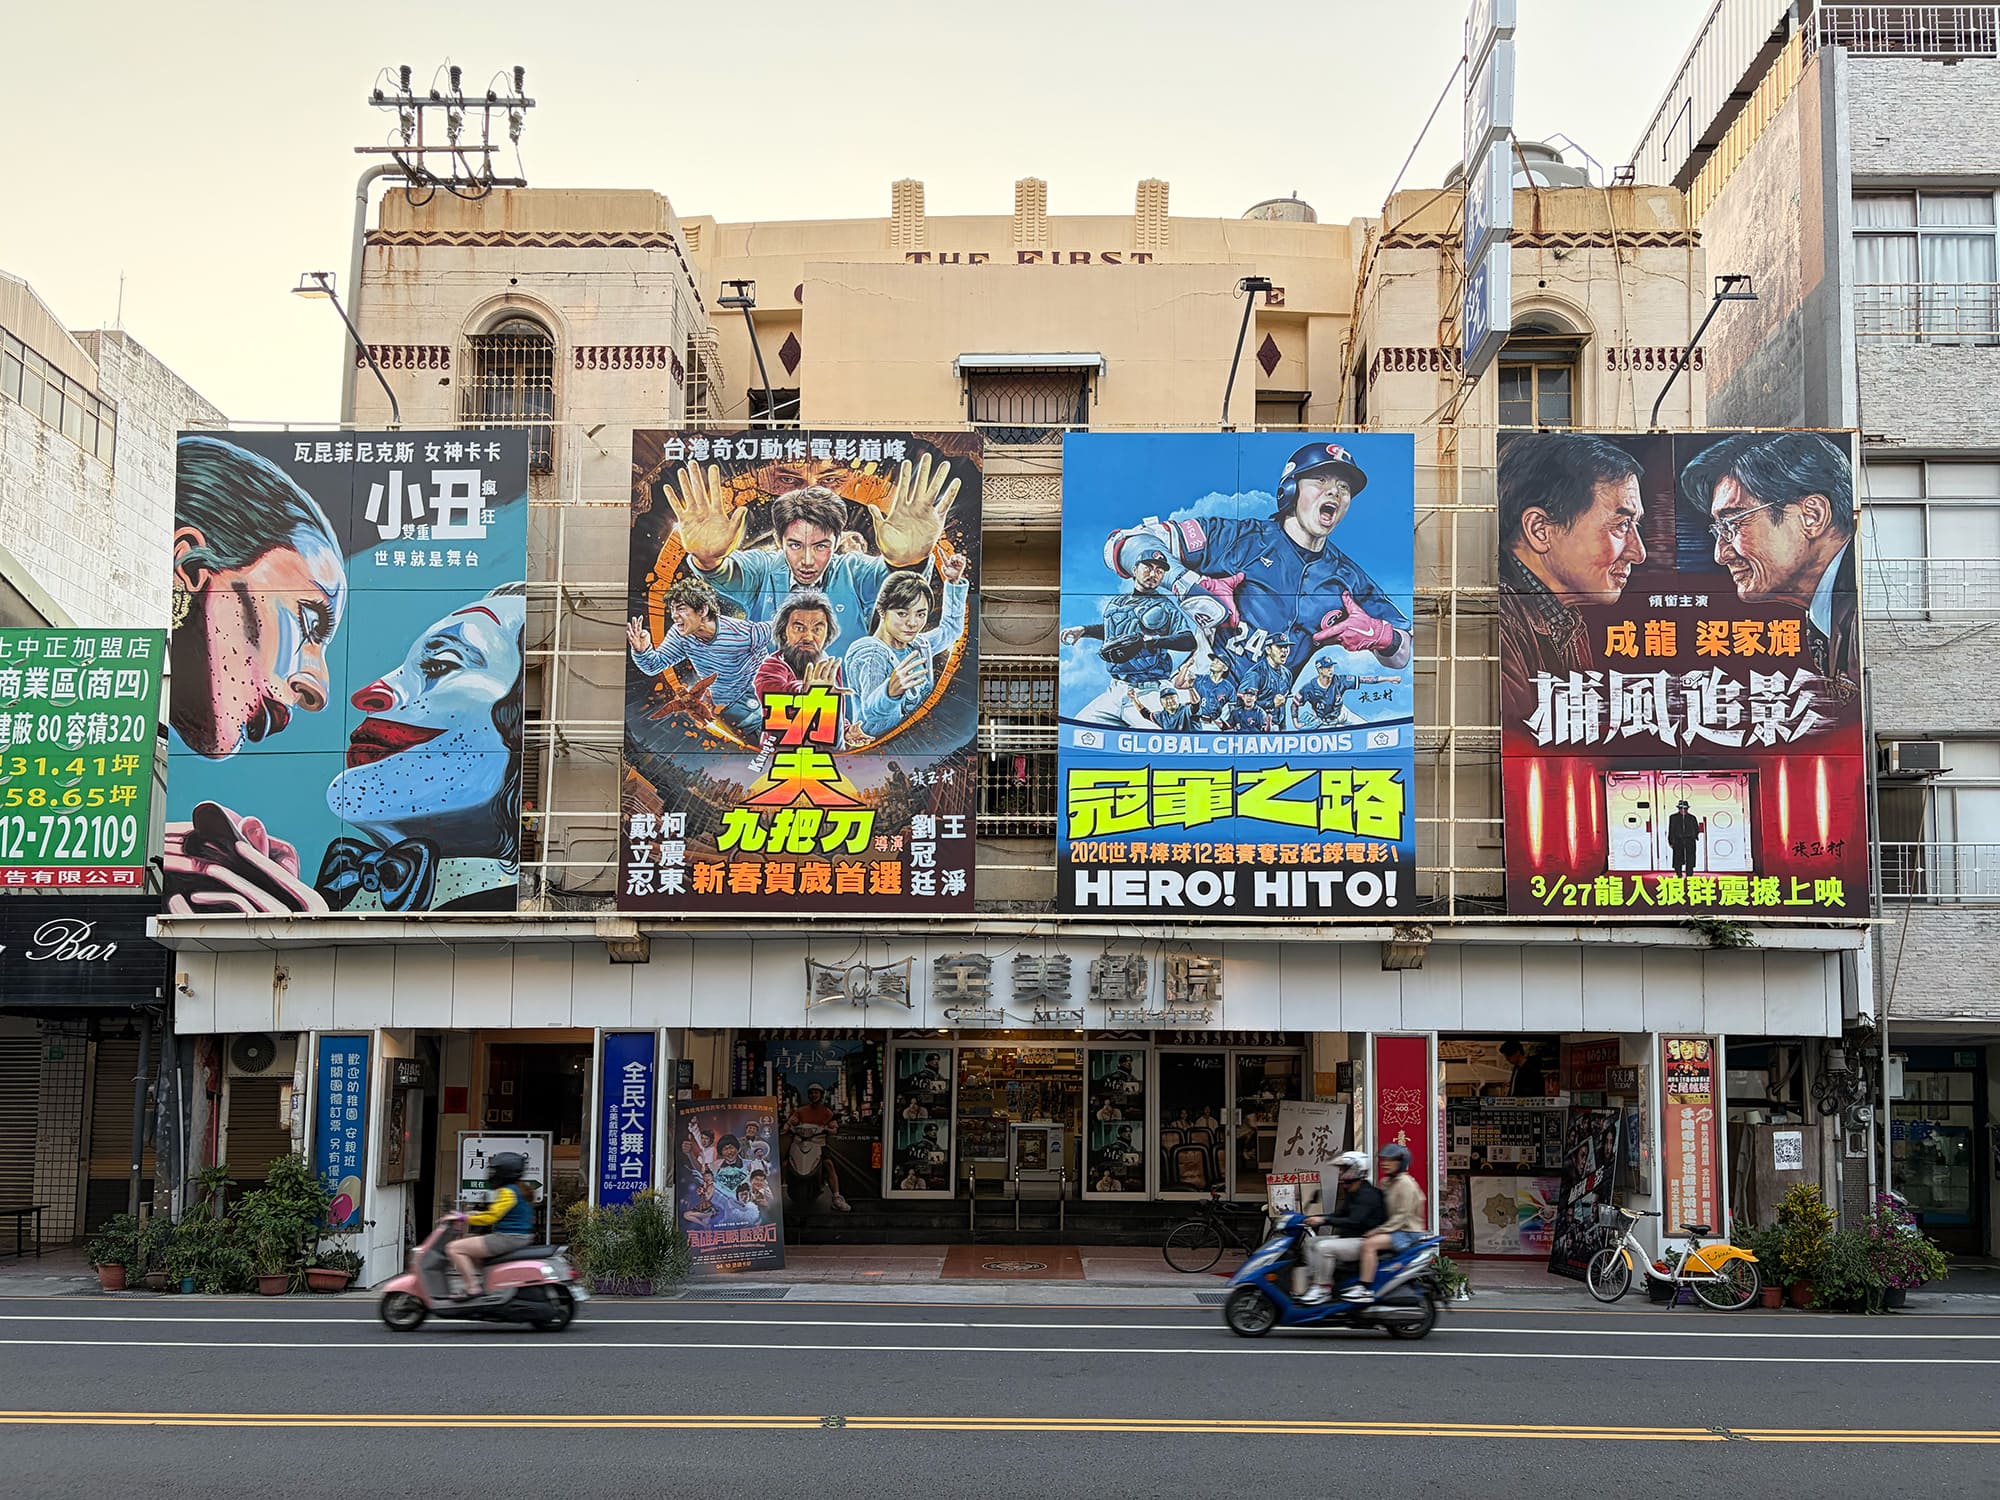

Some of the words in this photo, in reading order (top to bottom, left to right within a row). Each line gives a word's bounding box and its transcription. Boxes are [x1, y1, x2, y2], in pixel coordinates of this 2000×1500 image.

[293, 442, 414, 463] 瓦昆菲尼克斯
[424, 441, 501, 463] 女神卡卡
[663, 437, 907, 463] 台灣奇幻動作電影巔峰
[364, 469, 487, 540] 小丑
[480, 480, 498, 525] 瘋狂
[401, 524, 430, 541] 雙重
[374, 550, 480, 568] 世界就是舞台
[1604, 619, 1679, 659] 成龍
[1695, 618, 1802, 657] 梁家輝
[1523, 665, 1830, 748] 捕風追影
[737, 686, 867, 808] 功夫
[1117, 732, 1209, 754] GLOBAL
[1211, 732, 1353, 755] CHAMPIONS
[0, 754, 140, 776] 31.41坪
[5, 785, 138, 808] 58.65坪
[1066, 763, 1406, 842] 冠軍之路
[716, 808, 877, 855] 九把刀
[874, 835, 904, 852] 導演
[626, 812, 657, 896] 戴立忍
[658, 812, 687, 896] 柯震東
[910, 814, 938, 897] 劉冠廷
[0, 871, 136, 885] 告有限公司
[692, 860, 903, 896] 新春賀歲首選
[1075, 869, 1237, 907] HERO!
[1253, 870, 1398, 909] HITO!
[1530, 874, 1847, 908] 3/27龍入狼群震撼上映
[26, 918, 119, 962] Bar
[619, 1060, 647, 1179] 全民大舞台
[343, 1127, 357, 1167] 安親班
[603, 1180, 648, 1191] 06-2224726
